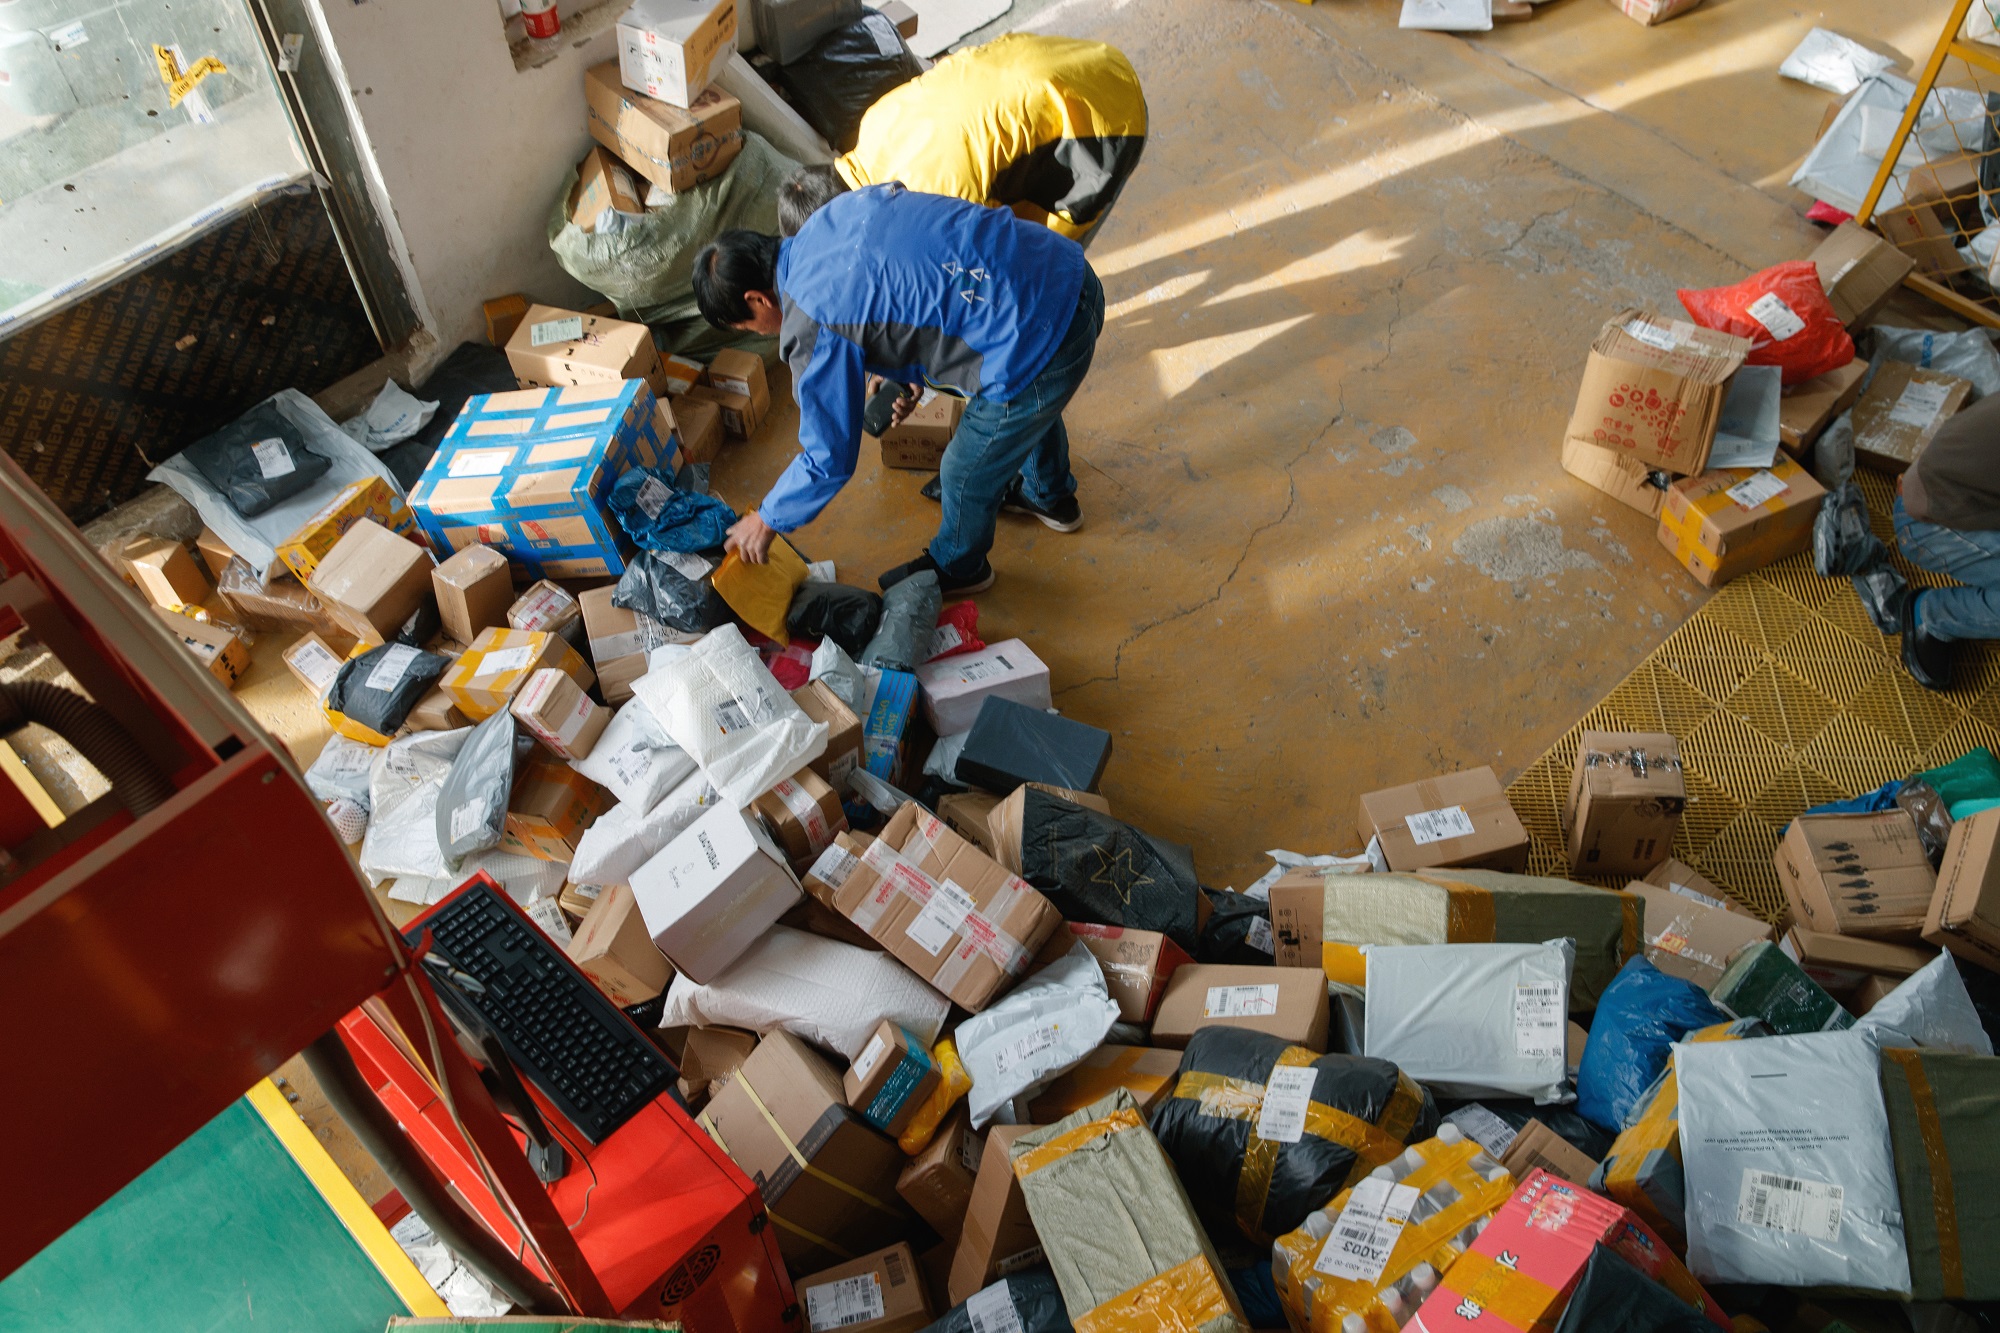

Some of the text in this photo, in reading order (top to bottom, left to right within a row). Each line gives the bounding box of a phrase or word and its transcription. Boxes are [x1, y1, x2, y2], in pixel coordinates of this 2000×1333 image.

[97, 273, 156, 384] MARINEPLEX
[118, 278, 178, 388] MARINEPLEX
[139, 283, 200, 392] MARINEPLEX
[1342, 1241, 1384, 1261] A003
